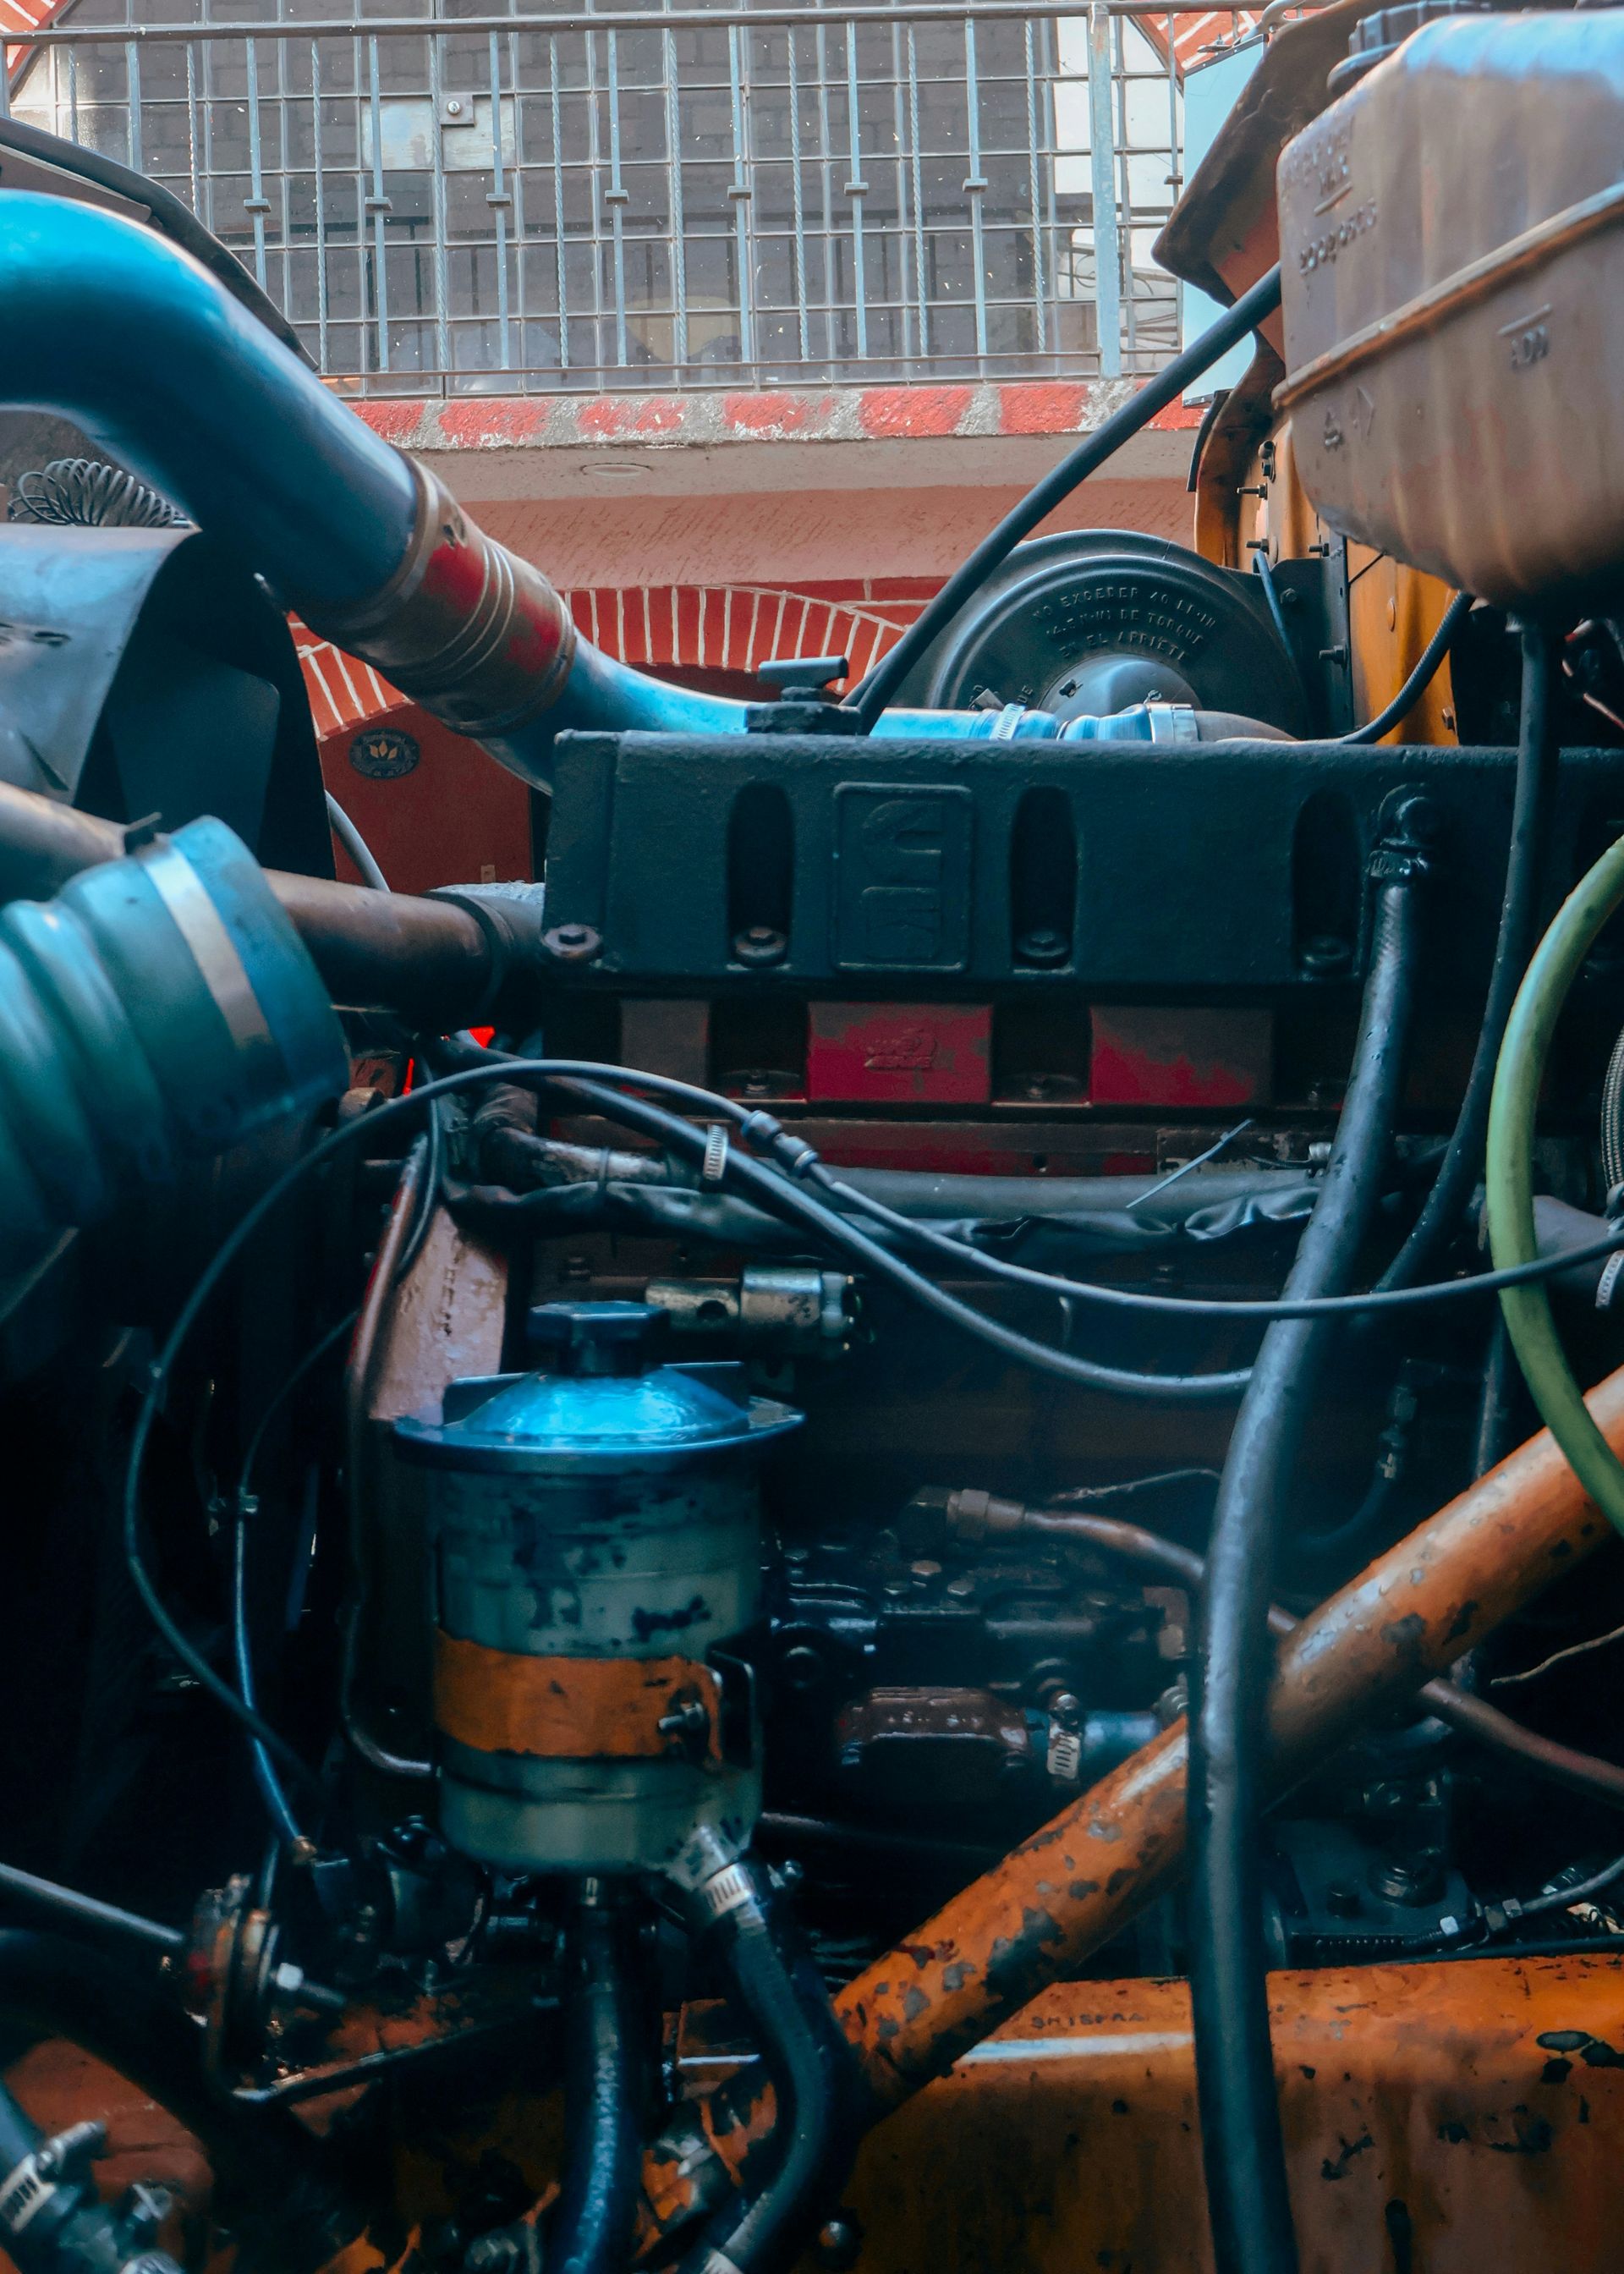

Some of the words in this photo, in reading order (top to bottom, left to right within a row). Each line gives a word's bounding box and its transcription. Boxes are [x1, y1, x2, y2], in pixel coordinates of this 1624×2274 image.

[1060, 586, 1138, 607] EXCEDER
[1120, 608, 1139, 620] DE
[1148, 612, 1204, 645] TORQUE
[1086, 633, 1110, 646] EL
